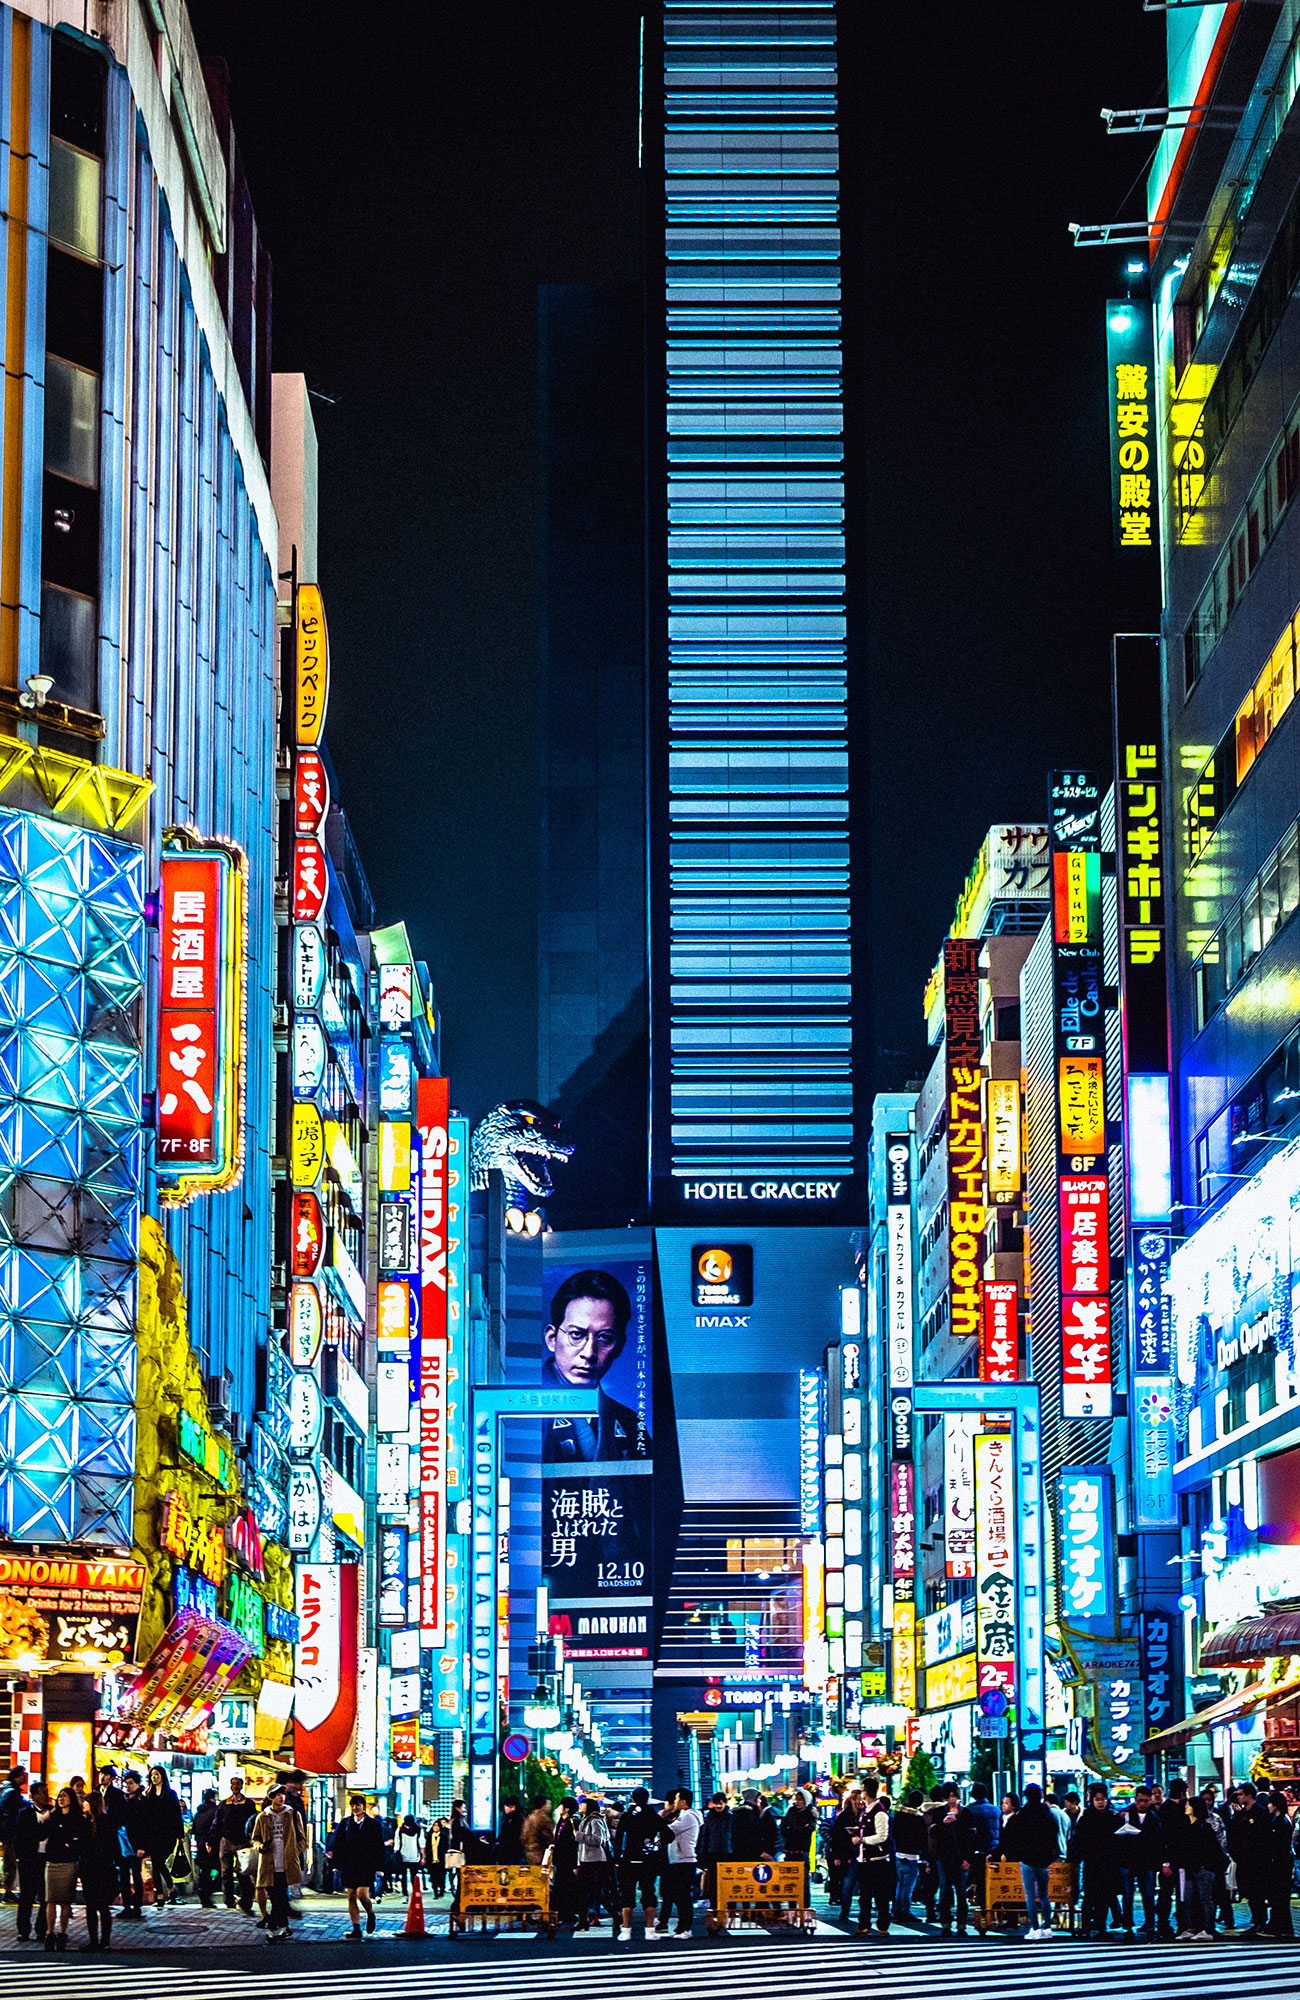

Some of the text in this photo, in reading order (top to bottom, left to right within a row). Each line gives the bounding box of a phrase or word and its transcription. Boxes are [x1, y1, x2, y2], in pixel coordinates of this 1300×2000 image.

[1115, 363, 1152, 546] 驚安の殿堂
[1126, 744, 1161, 964] ドン・キホーテ
[170, 891, 206, 999] 居酒屋
[1058, 948, 1100, 957] New Club
[1061, 996, 1080, 1033] Elle
[1070, 1038, 1091, 1048] 7F
[1071, 1156, 1096, 1172] 6F
[684, 1182, 841, 1200] HOTEL GRACERY
[996, 1191, 1014, 1203] 6F
[418, 1126, 448, 1292] SHIDAX
[695, 1316, 750, 1328] IMAX
[420, 1356, 440, 1482] BIC DRUG
[551, 1487, 625, 1520] 海賊と
[1146, 1493, 1169, 1508] 5F
[550, 1518, 619, 1538] よばれた
[549, 1538, 577, 1568] 男
[1067, 1480, 1103, 1610] カラオケ
[86, 1563, 145, 1589] YAKI
[475, 1441, 492, 1703] GODZILLA ROAD
[597, 1561, 645, 1580] 12.10
[952, 1560, 976, 1577] B1
[61, 1588, 81, 1599] with
[597, 1579, 644, 1588] ROADSHOW
[27, 1598, 58, 1610] Drinks
[59, 1600, 73, 1611] for
[74, 1601, 81, 1611] 2
[82, 1601, 109, 1613] hours
[981, 1571, 1014, 1657] 金の蔵
[301, 1573, 321, 1667] トラノコ
[577, 1616, 647, 1635] MARUHAN
[980, 1664, 1009, 1687] 2F
[1147, 1619, 1171, 1722] カラオケ
[1109, 1679, 1134, 1765] カラオケ
